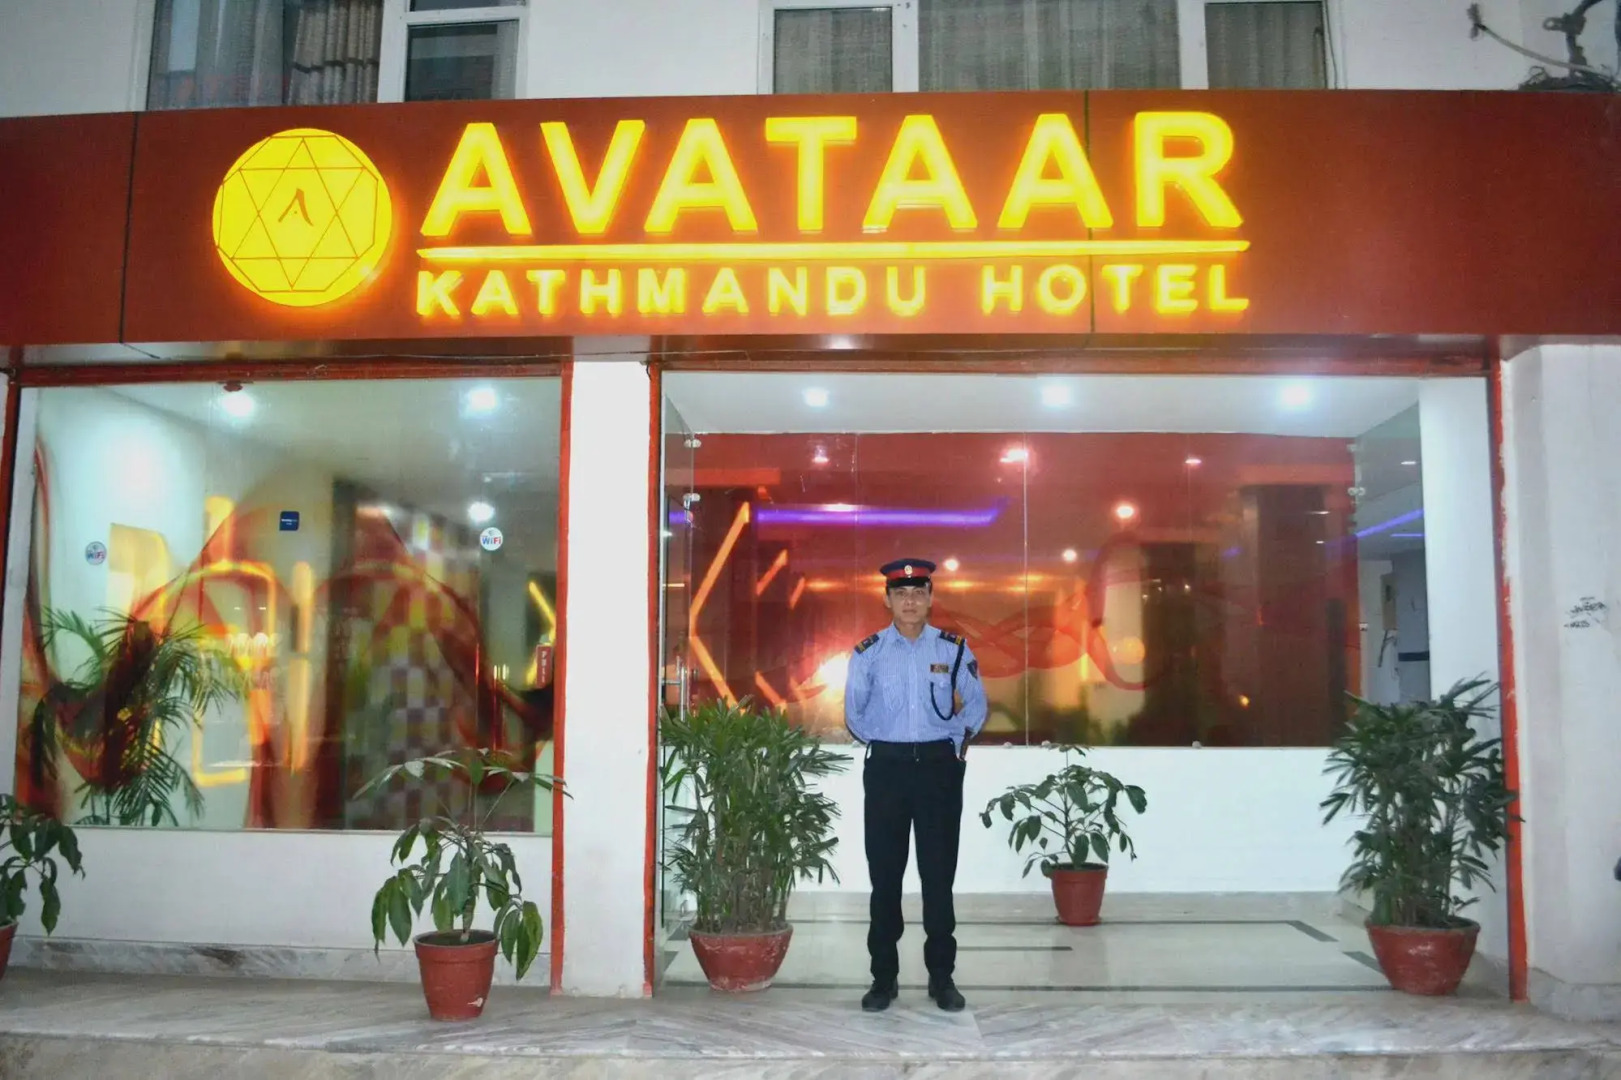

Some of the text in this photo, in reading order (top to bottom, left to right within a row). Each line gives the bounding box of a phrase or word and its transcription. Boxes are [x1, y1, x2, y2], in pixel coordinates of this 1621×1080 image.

[420, 111, 1243, 235] AVATAAR
[416, 264, 1250, 317] KATHMANDU HOTEL
